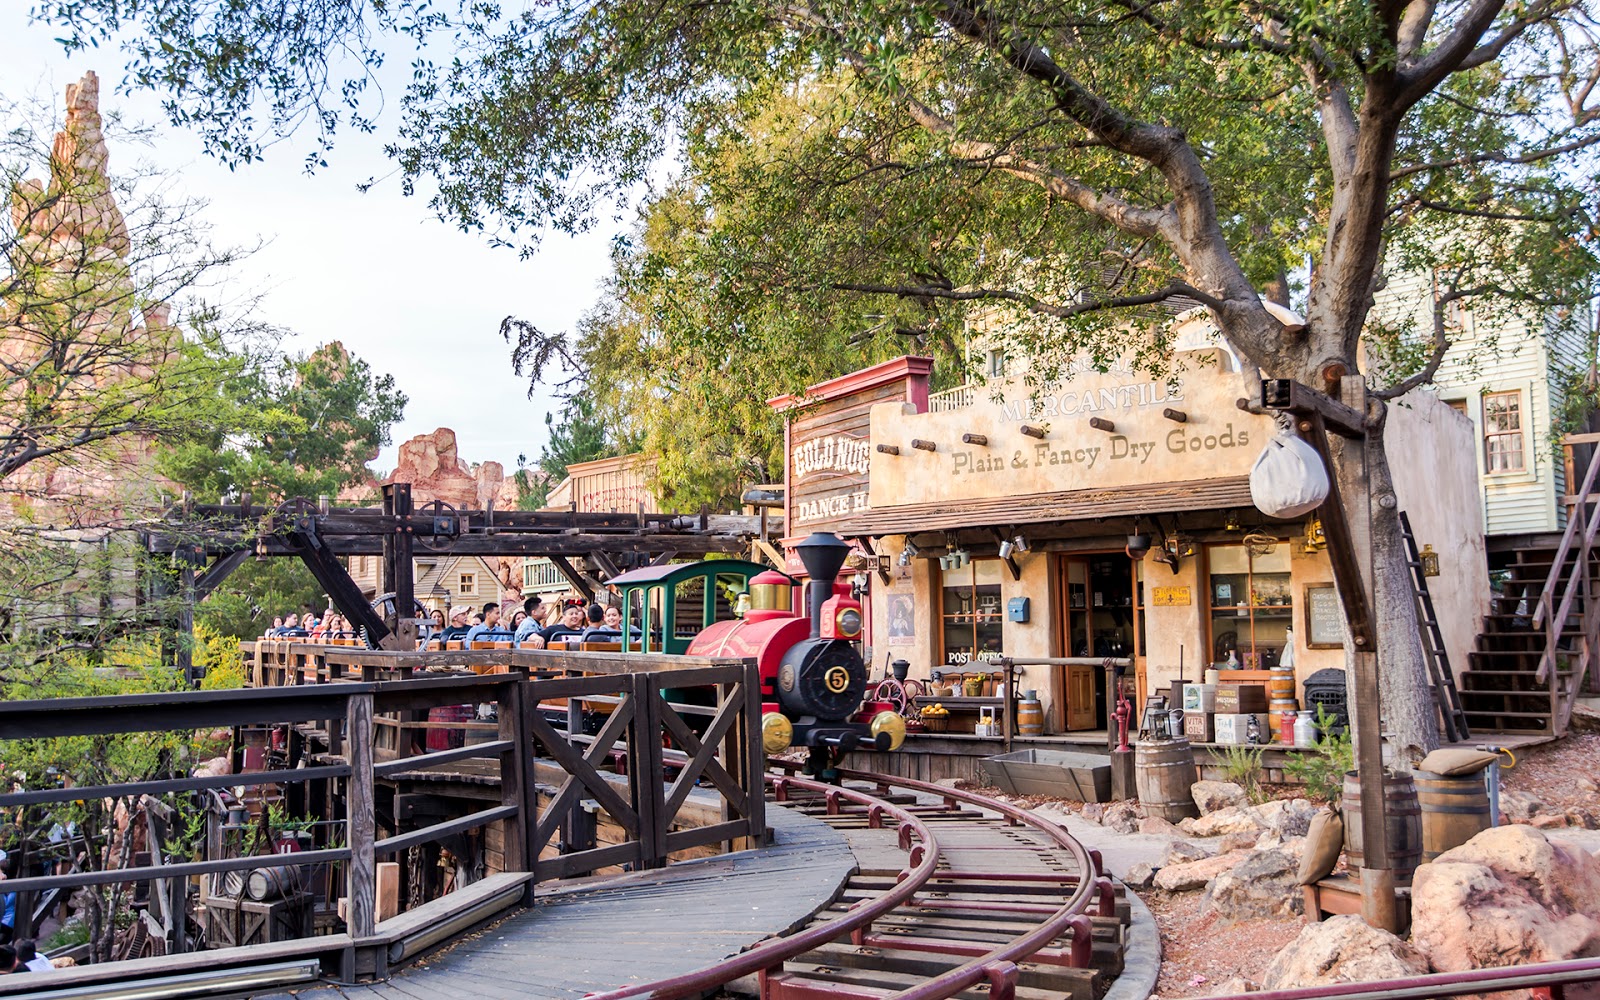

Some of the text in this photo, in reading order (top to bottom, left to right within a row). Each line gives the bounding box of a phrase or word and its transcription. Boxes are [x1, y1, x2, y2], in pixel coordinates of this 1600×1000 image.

[1000, 379, 1185, 423] MERCANTILE
[794, 436, 870, 478] GOLD NUG
[951, 423, 1249, 475] Plain & Fancy Dry Goods
[799, 494, 850, 521] DANCE
[823, 611, 832, 634] 5
[948, 652, 973, 663] POST
[832, 672, 844, 688] 5
[1187, 717, 1203, 726] VITA
